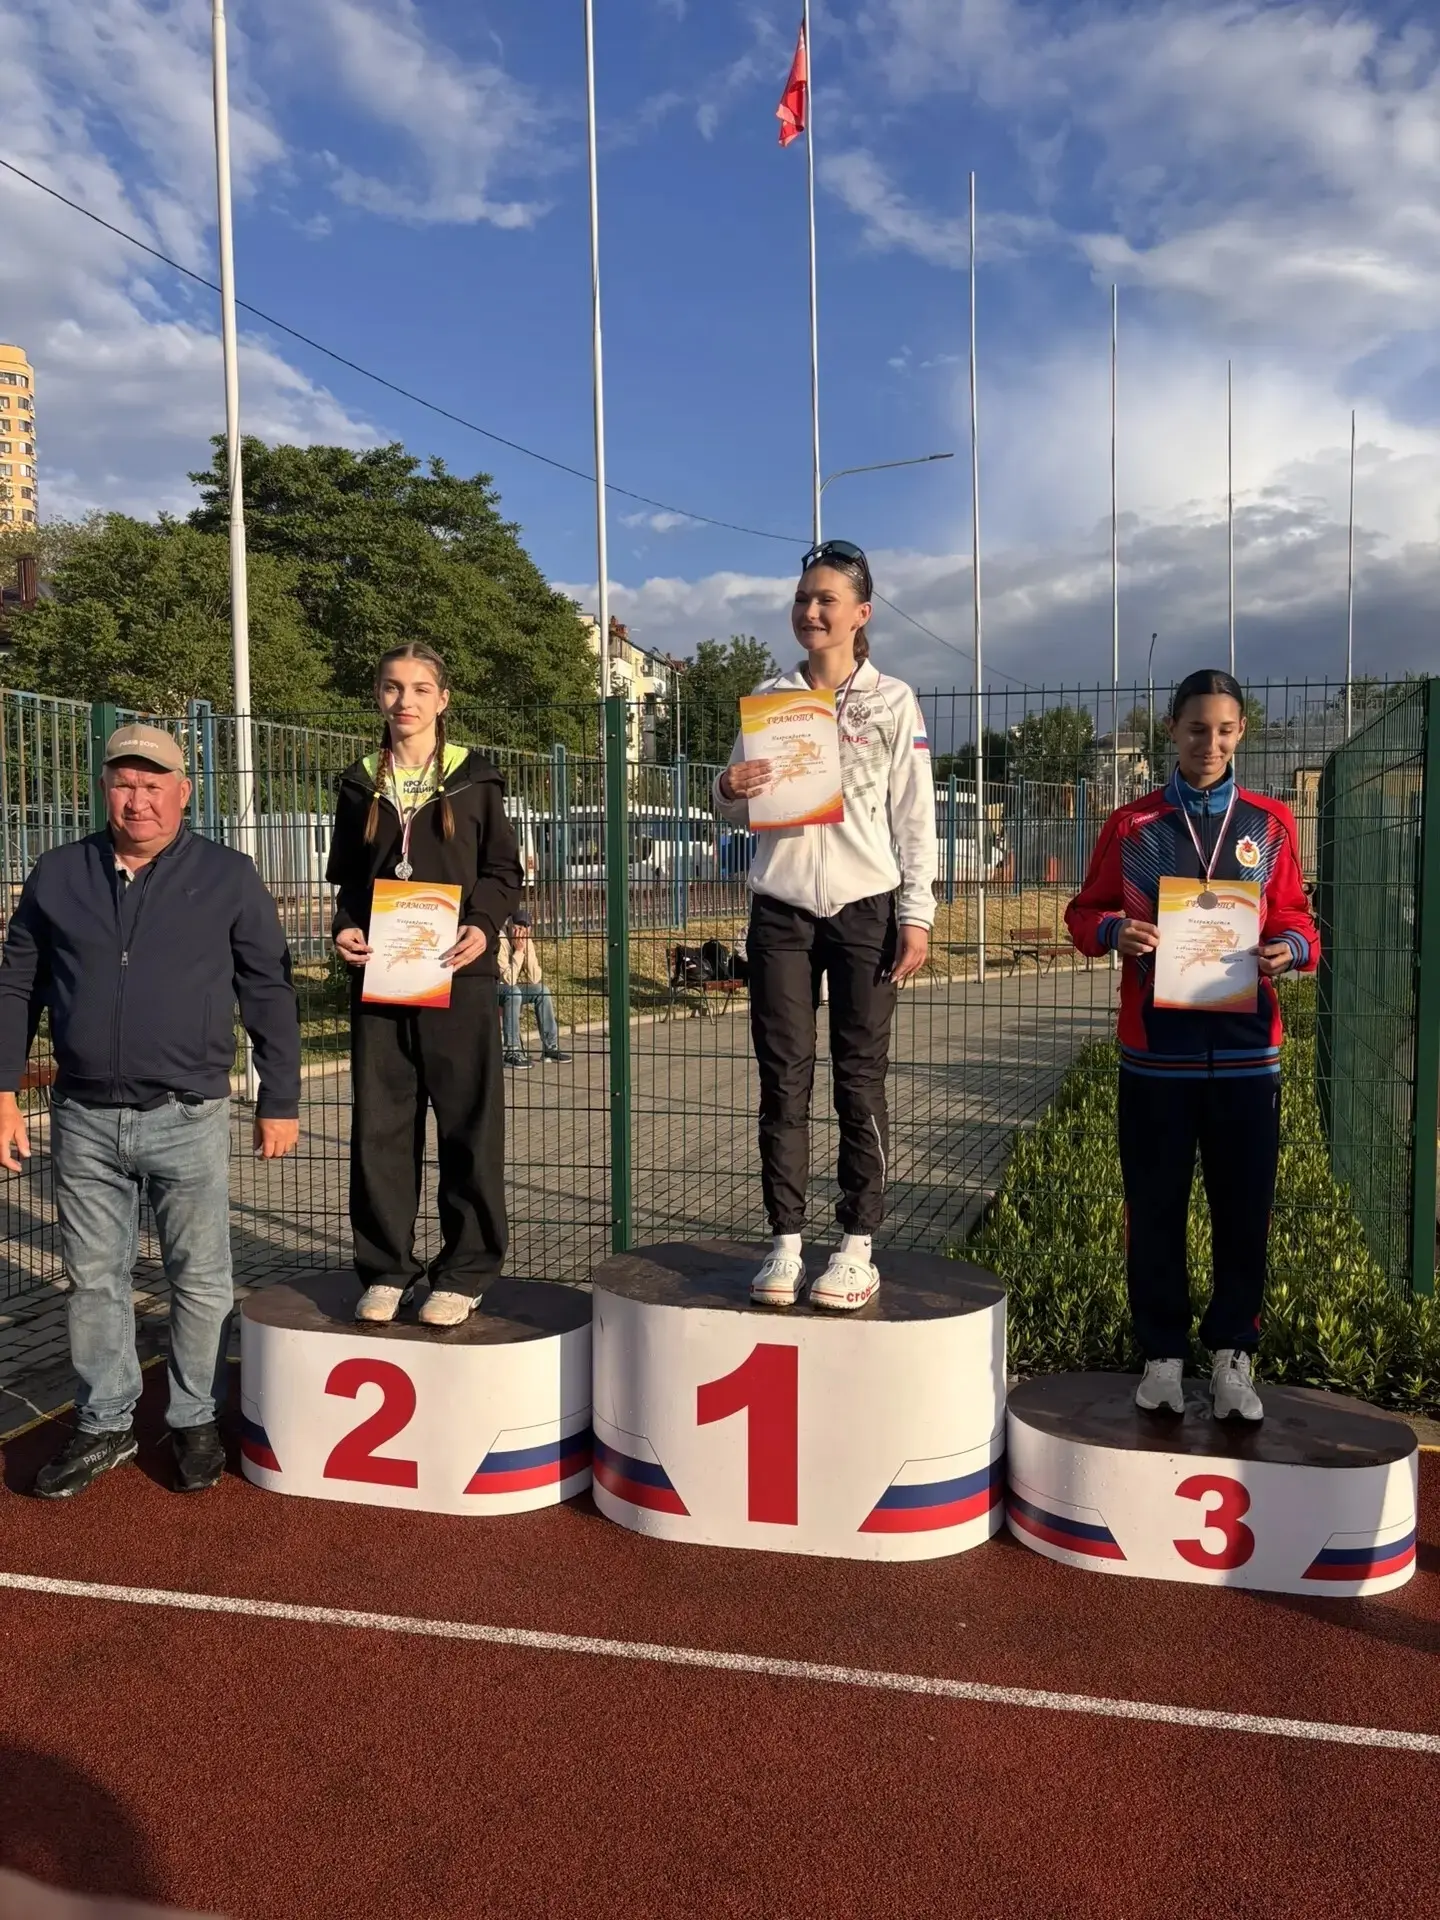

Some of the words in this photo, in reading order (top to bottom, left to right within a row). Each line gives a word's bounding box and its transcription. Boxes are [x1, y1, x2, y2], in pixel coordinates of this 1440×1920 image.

[767, 713, 814, 724] ГРАМОТА
[841, 734, 869, 745] RUS
[403, 780, 428, 788] КРОС
[322, 1357, 418, 1489] 2
[696, 1343, 799, 1526] 1
[1172, 1474, 1256, 1570] 3
